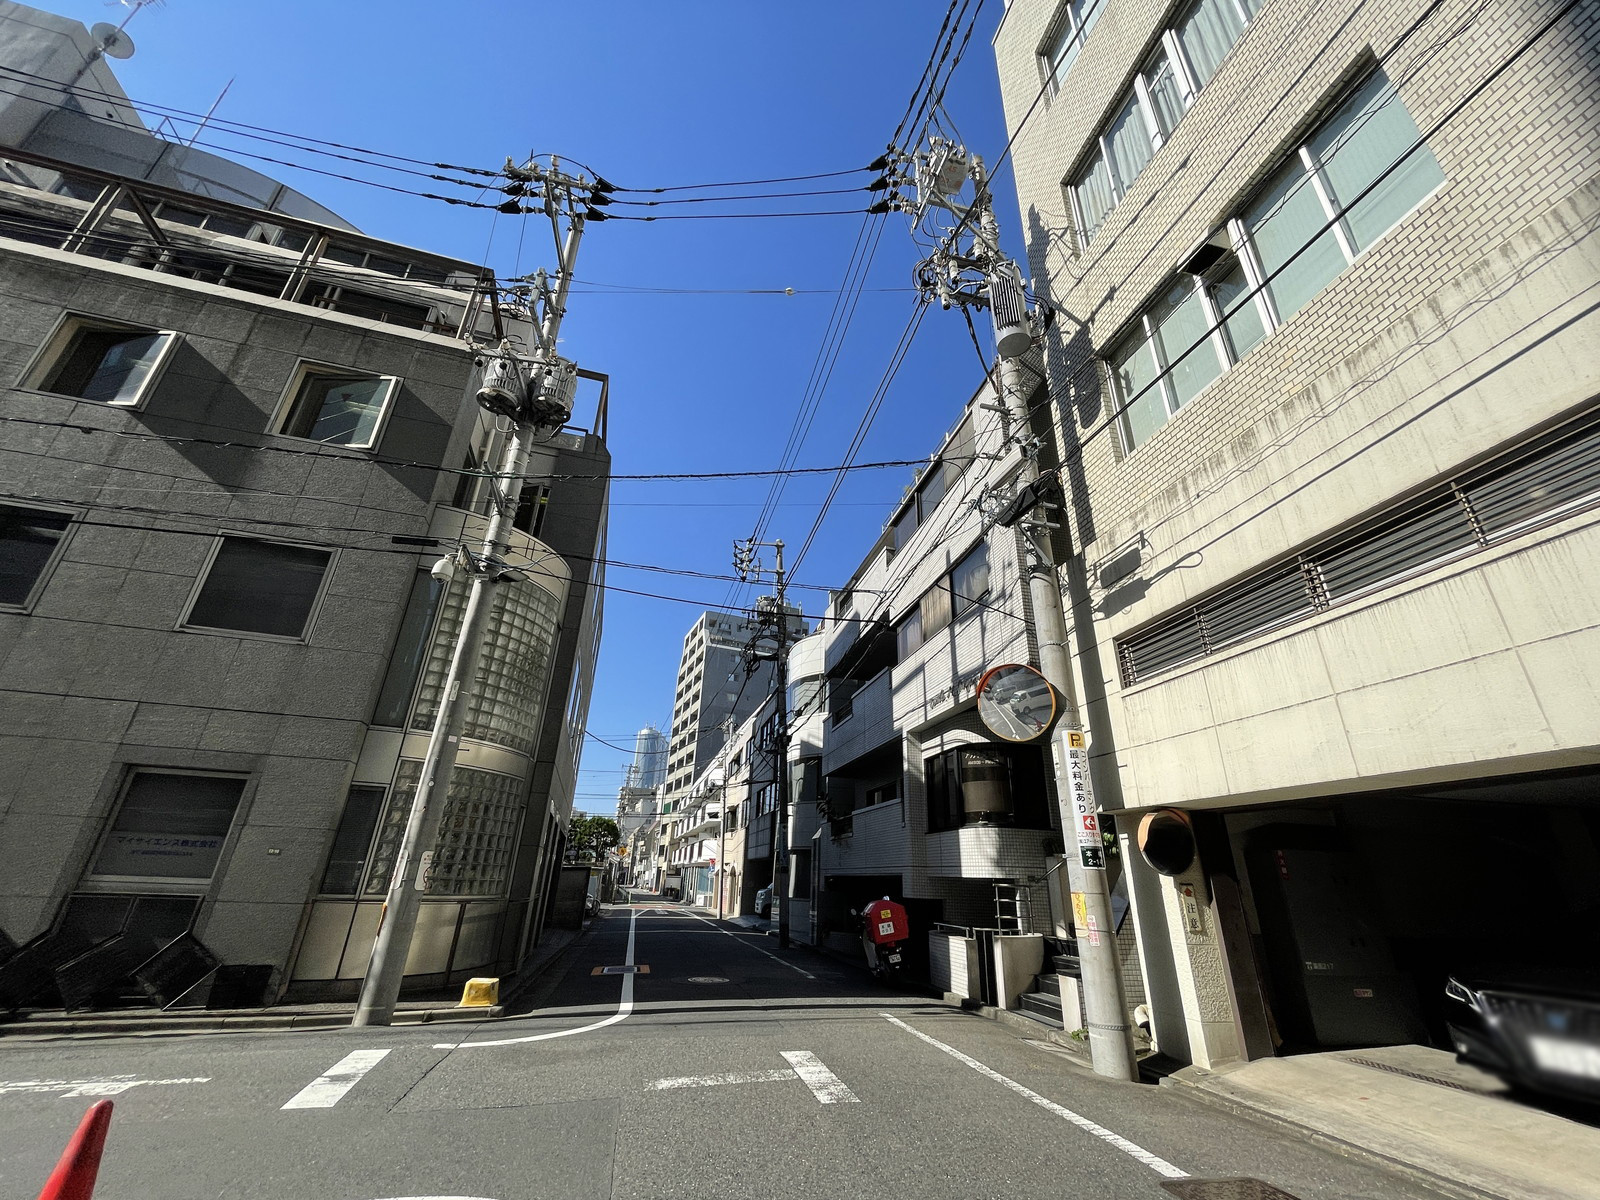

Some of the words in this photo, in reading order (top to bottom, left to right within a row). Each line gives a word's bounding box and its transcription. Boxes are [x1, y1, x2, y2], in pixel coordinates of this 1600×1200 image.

[1070, 733, 1081, 747] P
[1070, 749, 1086, 814] 最大料金あり
[1186, 902, 1200, 929] 注意
